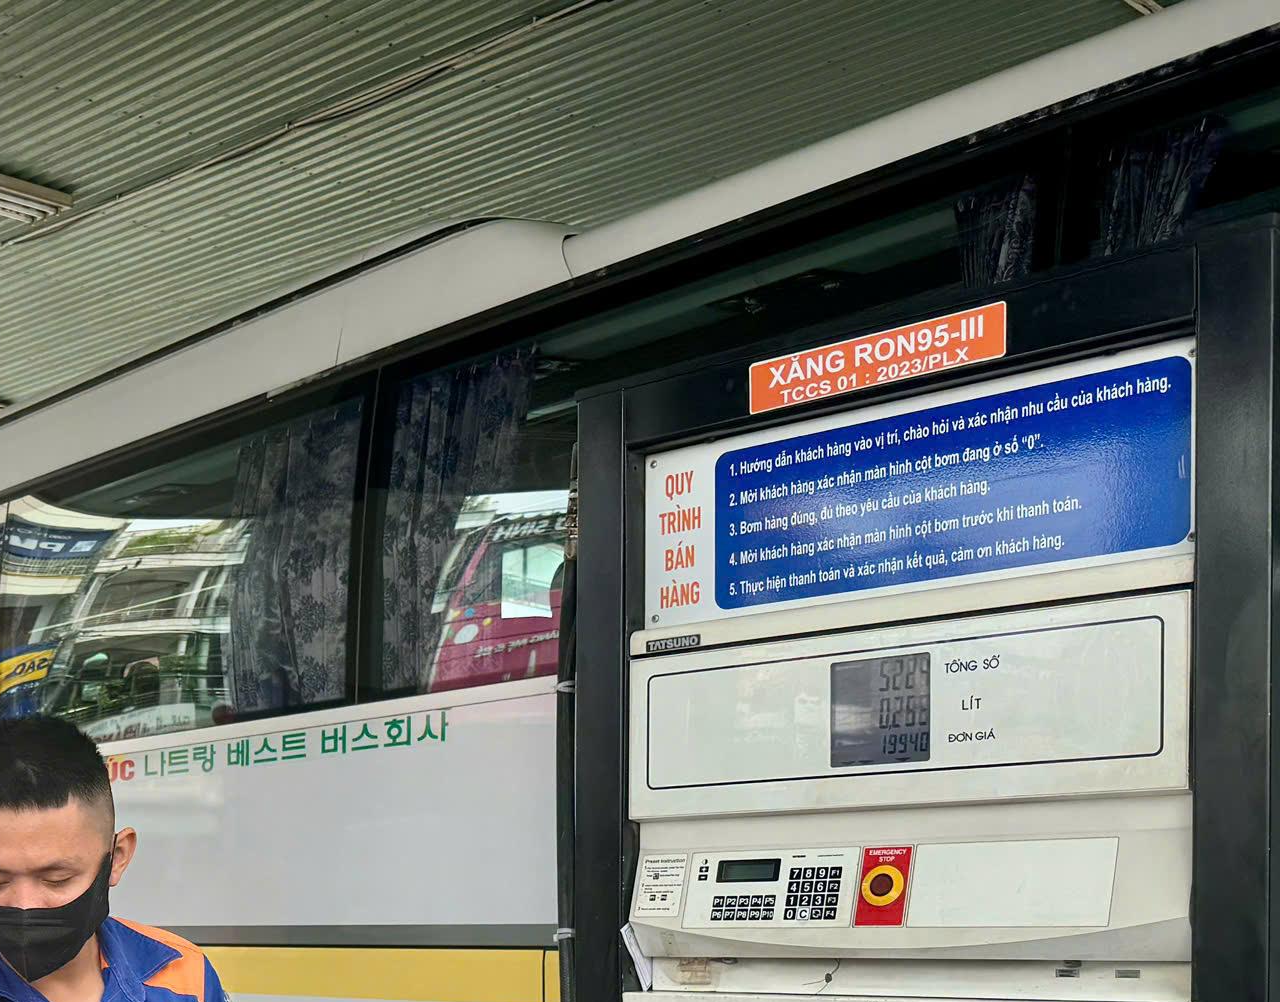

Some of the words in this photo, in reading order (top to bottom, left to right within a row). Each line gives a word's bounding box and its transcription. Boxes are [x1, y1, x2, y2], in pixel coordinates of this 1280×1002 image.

[769, 352, 845, 389] XĂNG
[854, 314, 984, 367] RON95-III
[780, 380, 832, 404] TCCS
[837, 373, 857, 391] 01
[876, 346, 969, 382] 2023/PLX
[729, 464, 737, 476] 1.
[740, 458, 772, 475] Hướng
[775, 450, 792, 467] dẫn
[795, 445, 824, 464] khách
[827, 442, 851, 457] hàng
[854, 436, 873, 451] vào
[875, 432, 884, 450] vị
[887, 429, 900, 445] trí,
[903, 424, 929, 441] chào
[932, 419, 949, 435] hỏi
[952, 416, 964, 431] và
[967, 412, 987, 429] xác
[990, 406, 1018, 424] nhận
[1021, 401, 1043, 418] nhu
[1047, 392, 1068, 412] cầu
[1071, 390, 1092, 407] của
[1096, 382, 1133, 402] khách
[1136, 376, 1171, 394] hàng.
[665, 470, 694, 500] QUY
[729, 494, 737, 507] 2.
[740, 487, 758, 505] Mời
[759, 483, 788, 501] khách
[790, 480, 814, 496] hàng
[817, 474, 834, 490] xác
[837, 469, 861, 487] nhận
[864, 464, 886, 481] màn
[889, 459, 912, 476] hình
[915, 456, 932, 473] cột
[934, 451, 960, 468] bơm
[962, 447, 990, 463] đang
[993, 441, 1002, 457] ở
[1004, 434, 1019, 454] số
[659, 505, 701, 536] TRÌNH
[729, 524, 737, 537] 3.
[740, 520, 763, 535] Bơm
[764, 516, 788, 530] hàng
[790, 510, 818, 526] đúng,
[820, 504, 833, 521] đủ
[835, 503, 857, 518] theo
[861, 498, 879, 517] yêu
[881, 491, 900, 509] cầu
[903, 489, 922, 506] của
[924, 483, 957, 501] khách
[960, 479, 991, 496] hàng.
[729, 553, 737, 566] 4.
[740, 549, 758, 565] Mời
[759, 544, 788, 562] khách
[790, 541, 814, 557] hàng
[817, 535, 834, 551] xác
[837, 532, 861, 550] nhận
[864, 527, 886, 543] màn
[889, 523, 912, 541] hình
[914, 520, 932, 538] cột
[934, 516, 959, 532] bơm
[962, 509, 994, 528] trước
[996, 505, 1014, 523] khi
[1017, 500, 1050, 519] thanh
[1052, 495, 1082, 514] toán.
[665, 541, 695, 572] BÁN
[729, 582, 737, 596] 5.
[739, 579, 764, 596] Thực
[766, 575, 787, 592] hiện
[789, 569, 816, 587] thanh
[819, 567, 840, 582] toán
[843, 563, 855, 578] và
[857, 559, 876, 576] xác
[878, 557, 903, 576] nhận
[906, 550, 923, 568] kết
[925, 550, 948, 568] quả,
[951, 546, 974, 563] cảm
[977, 546, 993, 558] ơn
[995, 537, 1029, 556] khách
[1032, 533, 1065, 551] hàng.
[660, 579, 700, 609] HÀNG
[648, 636, 698, 651] TATSUNO
[944, 658, 978, 674] TỔNG
[983, 654, 1001, 670] SỐ
[961, 695, 982, 711] LÍT
[144, 743, 216, 777] 나트랑
[226, 732, 307, 768] 베스트
[320, 711, 449, 755] 버스회사
[948, 730, 972, 743] ĐƠN
[975, 728, 996, 741] GIÁ
[869, 848, 907, 856] EMERGENCY
[712, 911, 722, 919] P6
[724, 911, 734, 919] P7
[714, 898, 723, 906] P1
[726, 898, 736, 906] P2
[752, 897, 762, 905] P4
[764, 897, 775, 905] P5
